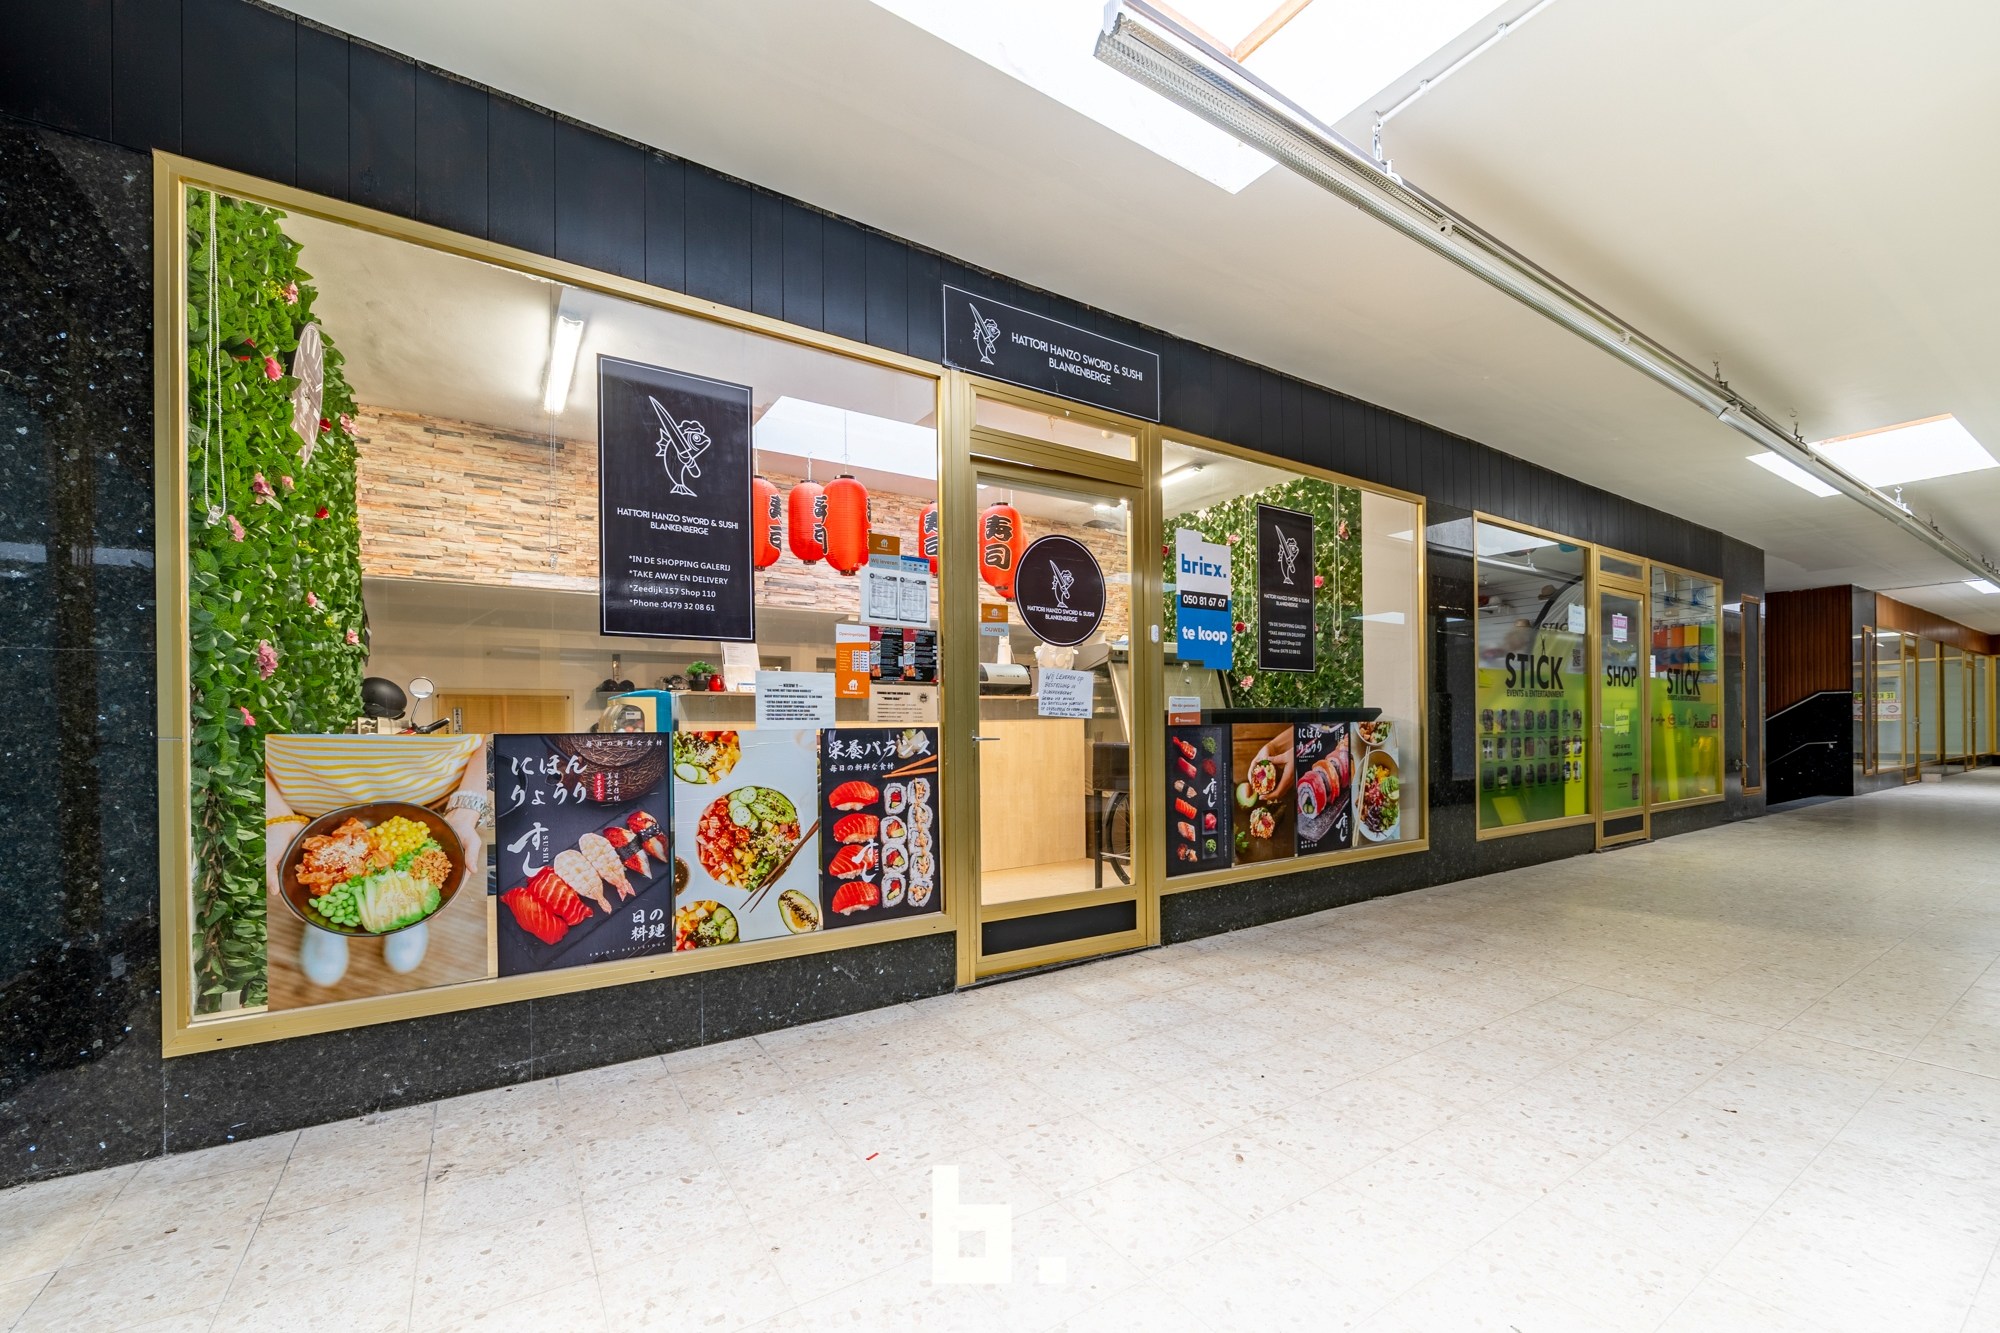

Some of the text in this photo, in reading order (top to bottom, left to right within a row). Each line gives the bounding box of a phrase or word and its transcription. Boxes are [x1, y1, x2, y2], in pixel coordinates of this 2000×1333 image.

[1012, 333, 1142, 381] HATTORI HANZO SWORD & SUSHI
[1049, 358, 1111, 385] BLANKENBERGE
[617, 508, 650, 518] HATTORI
[652, 512, 680, 522] HANZO
[682, 516, 709, 526] SWORD
[718, 520, 739, 529] SUSHI
[650, 522, 709, 535] BLANKENBERGE
[985, 514, 1012, 570] 寿司
[644, 556, 655, 564] DE
[657, 558, 698, 568] SHOPPING
[701, 562, 730, 572] GALERIJ
[655, 572, 678, 580] AWAY
[693, 575, 728, 584] DELIVERY
[681, 588, 700, 598] Shop
[1183, 594, 1226, 608] 050 81 67 67
[1045, 614, 1078, 622] BLANKENBERGE
[1182, 626, 1227, 645] te koop
[1505, 652, 1564, 690] STICK
[1607, 665, 1637, 687] SHOP
[1667, 668, 1701, 695] STICK
[1506, 689, 1524, 697] EVENTS
[1298, 728, 1322, 739] にほん
[828, 739, 932, 760] 栄養バランス
[511, 754, 588, 775] にほん
[830, 762, 894, 772] 毎日の新鮮な食材
[511, 783, 587, 807] りょうり
[1203, 778, 1217, 807] すし
[1336, 812, 1348, 842] すし
[507, 822, 549, 878] すし
[852, 838, 879, 882] すし
[632, 908, 664, 923] 日の
[630, 923, 665, 941] 料理
